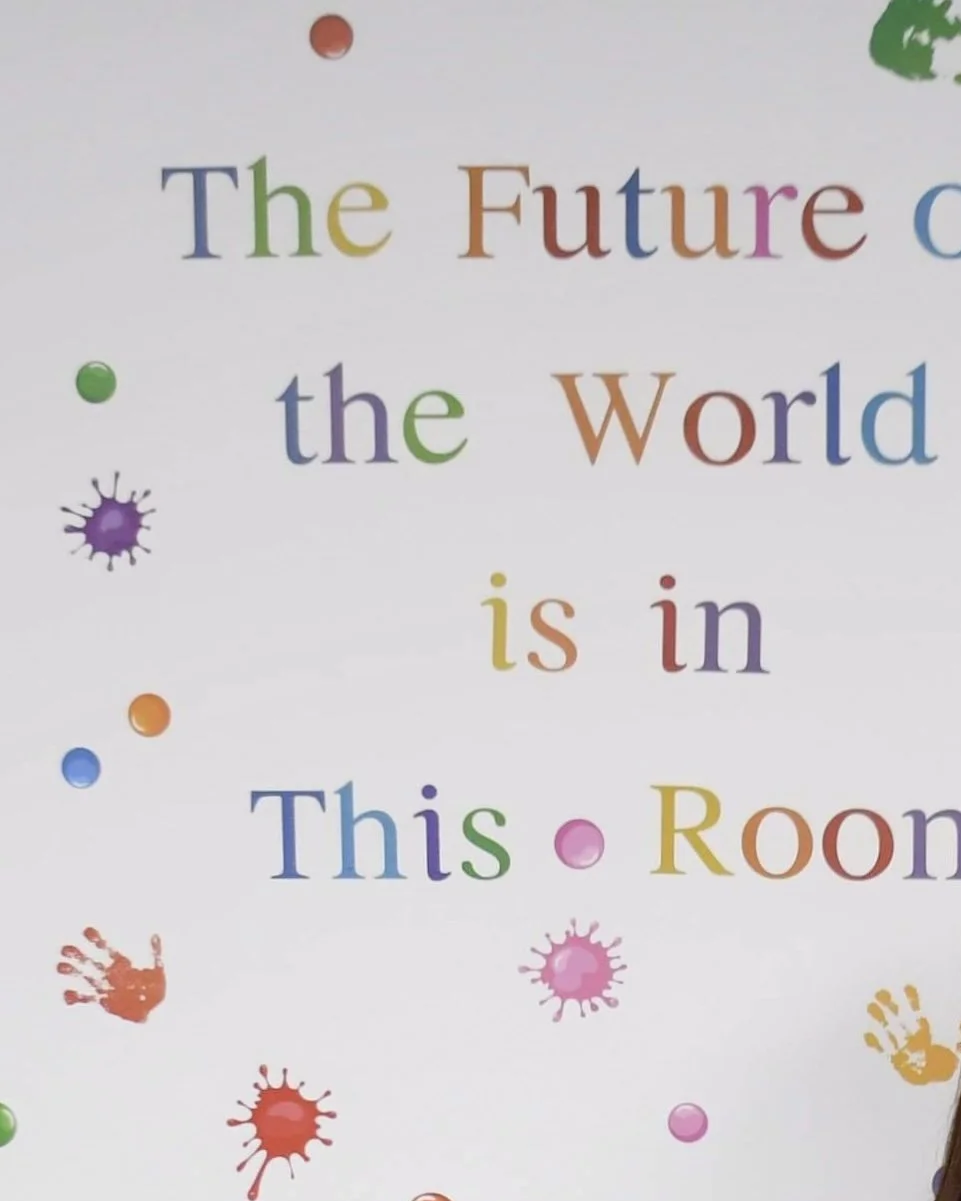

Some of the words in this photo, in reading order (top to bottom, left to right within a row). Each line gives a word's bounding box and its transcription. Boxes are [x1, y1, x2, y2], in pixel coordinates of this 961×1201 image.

[161, 155, 392, 260] The
[458, 164, 868, 261] Future
[275, 362, 468, 466] the
[551, 361, 938, 467] World
[481, 572, 578, 673] is
[651, 575, 770, 674] in
[250, 781, 511, 881] This
